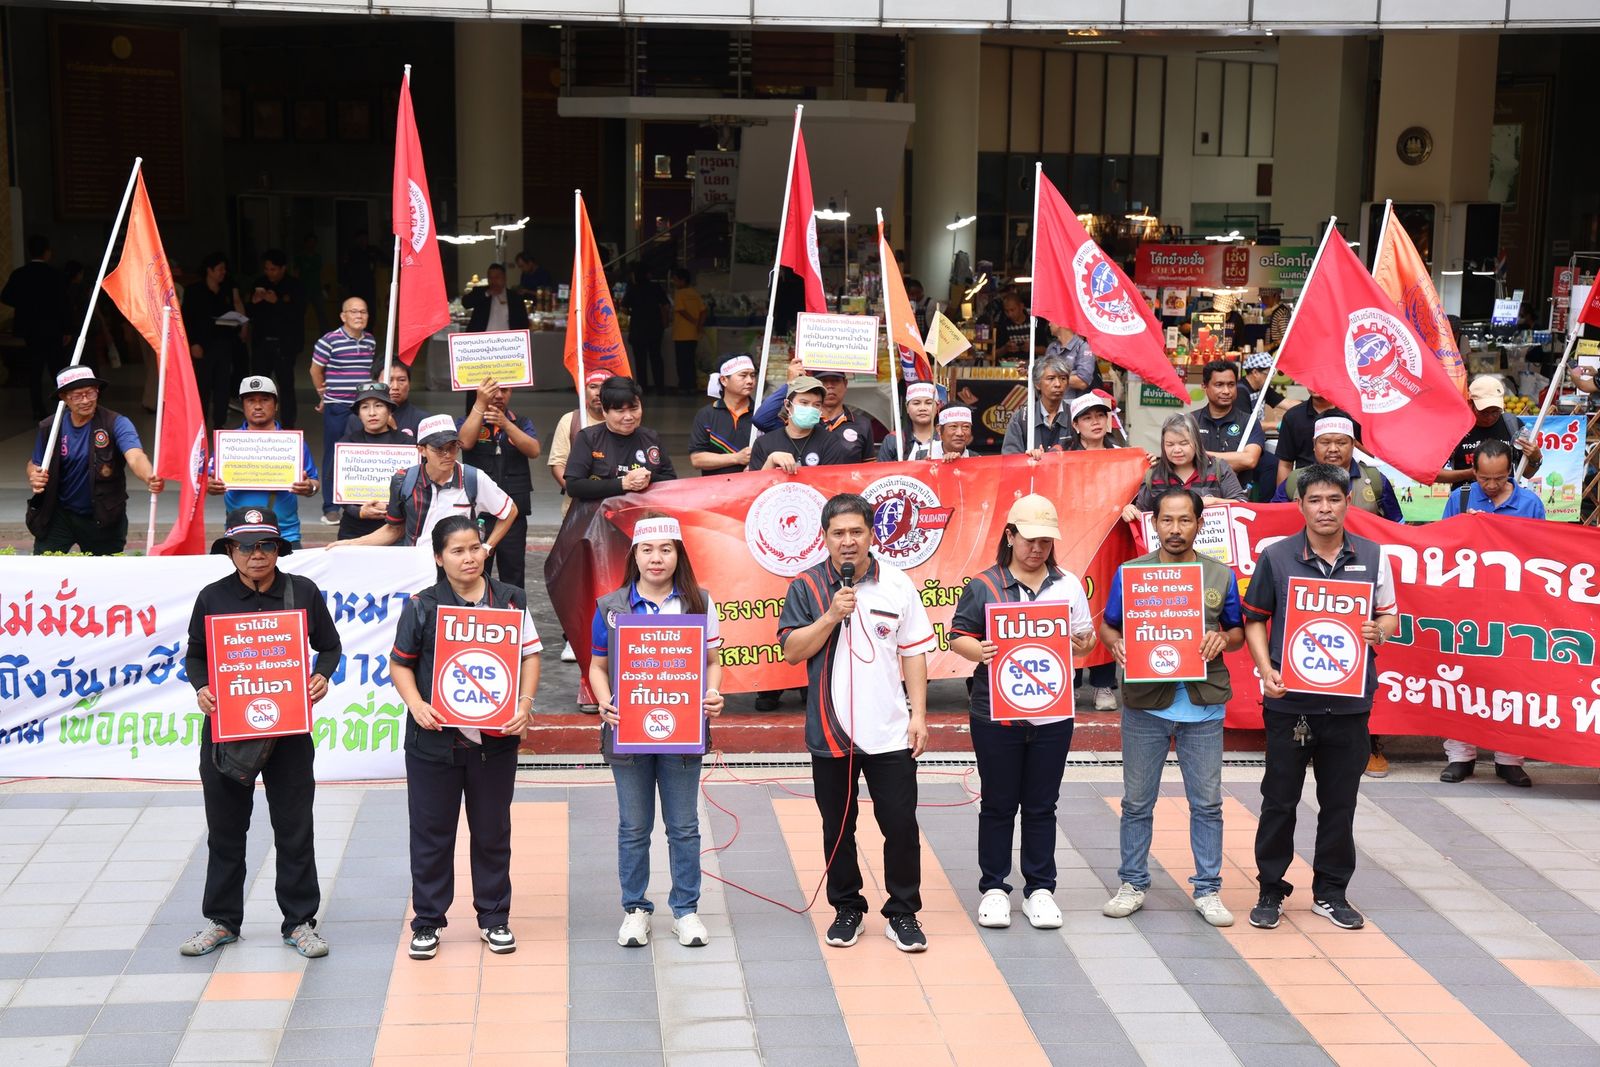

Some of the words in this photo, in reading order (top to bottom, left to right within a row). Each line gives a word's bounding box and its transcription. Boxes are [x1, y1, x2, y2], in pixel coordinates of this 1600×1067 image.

[453, 336, 524, 346] กองทุนประกันสังคมเป็น
[803, 333, 871, 342] แต่เป็นความหน้าด้าน
[805, 341, 868, 350] ที่แก้ไขปัญหาไม่เป็น
[1391, 370, 1421, 395] SOLIDARITY
[221, 436, 297, 445] กองทุนประกันสังคมเป็น
[344, 473, 391, 482] ที่แก้ไขปัญหา
[918, 513, 948, 523] SOLIDARITY
[1195, 536, 1223, 545] าไม่เป็น
[1142, 569, 1182, 580] เราไม่ใช่
[1131, 583, 1159, 593] Fake
[1162, 584, 1194, 592] news
[1135, 596, 1163, 606] เราคือ
[1294, 585, 1368, 615] ไม่เอา
[1126, 609, 1157, 619] ตัวจริง
[1160, 608, 1200, 618] เสียงจริง
[235, 617, 278, 631] เราไม่ใช่
[994, 612, 1068, 639] ไม่เอา
[442, 615, 519, 645] ไม่เอา
[641, 630, 681, 641] เราไม่ใช่
[1135, 620, 1193, 641] ที่ไม่เอา
[223, 634, 254, 645] Fake
[258, 633, 292, 643] news
[1302, 632, 1345, 653] สูตร
[227, 648, 258, 659] เราคือ
[628, 644, 656, 654] Fake
[660, 645, 693, 654] news
[219, 663, 252, 672] ตัวจริง
[255, 659, 300, 670] เสียงจริง
[631, 658, 660, 669] เราคือ
[1155, 660, 1176, 669] CARE
[1302, 656, 1350, 672] CARE
[452, 664, 497, 685] สูตร
[1008, 659, 1051, 680] สูตร
[621, 671, 653, 681] ตัวจริง
[656, 671, 699, 681] เสียงจริง
[229, 674, 293, 696] ที่ไม่เอา
[1011, 682, 1057, 697] CARE
[453, 689, 501, 704] CARE
[630, 683, 690, 705] ที่ไม่เอา
[1377, 664, 1561, 729] ระกันตน
[252, 714, 274, 723] CARE
[58, 693, 204, 760] เพื่อคุณภ
[649, 725, 671, 733] CARE
